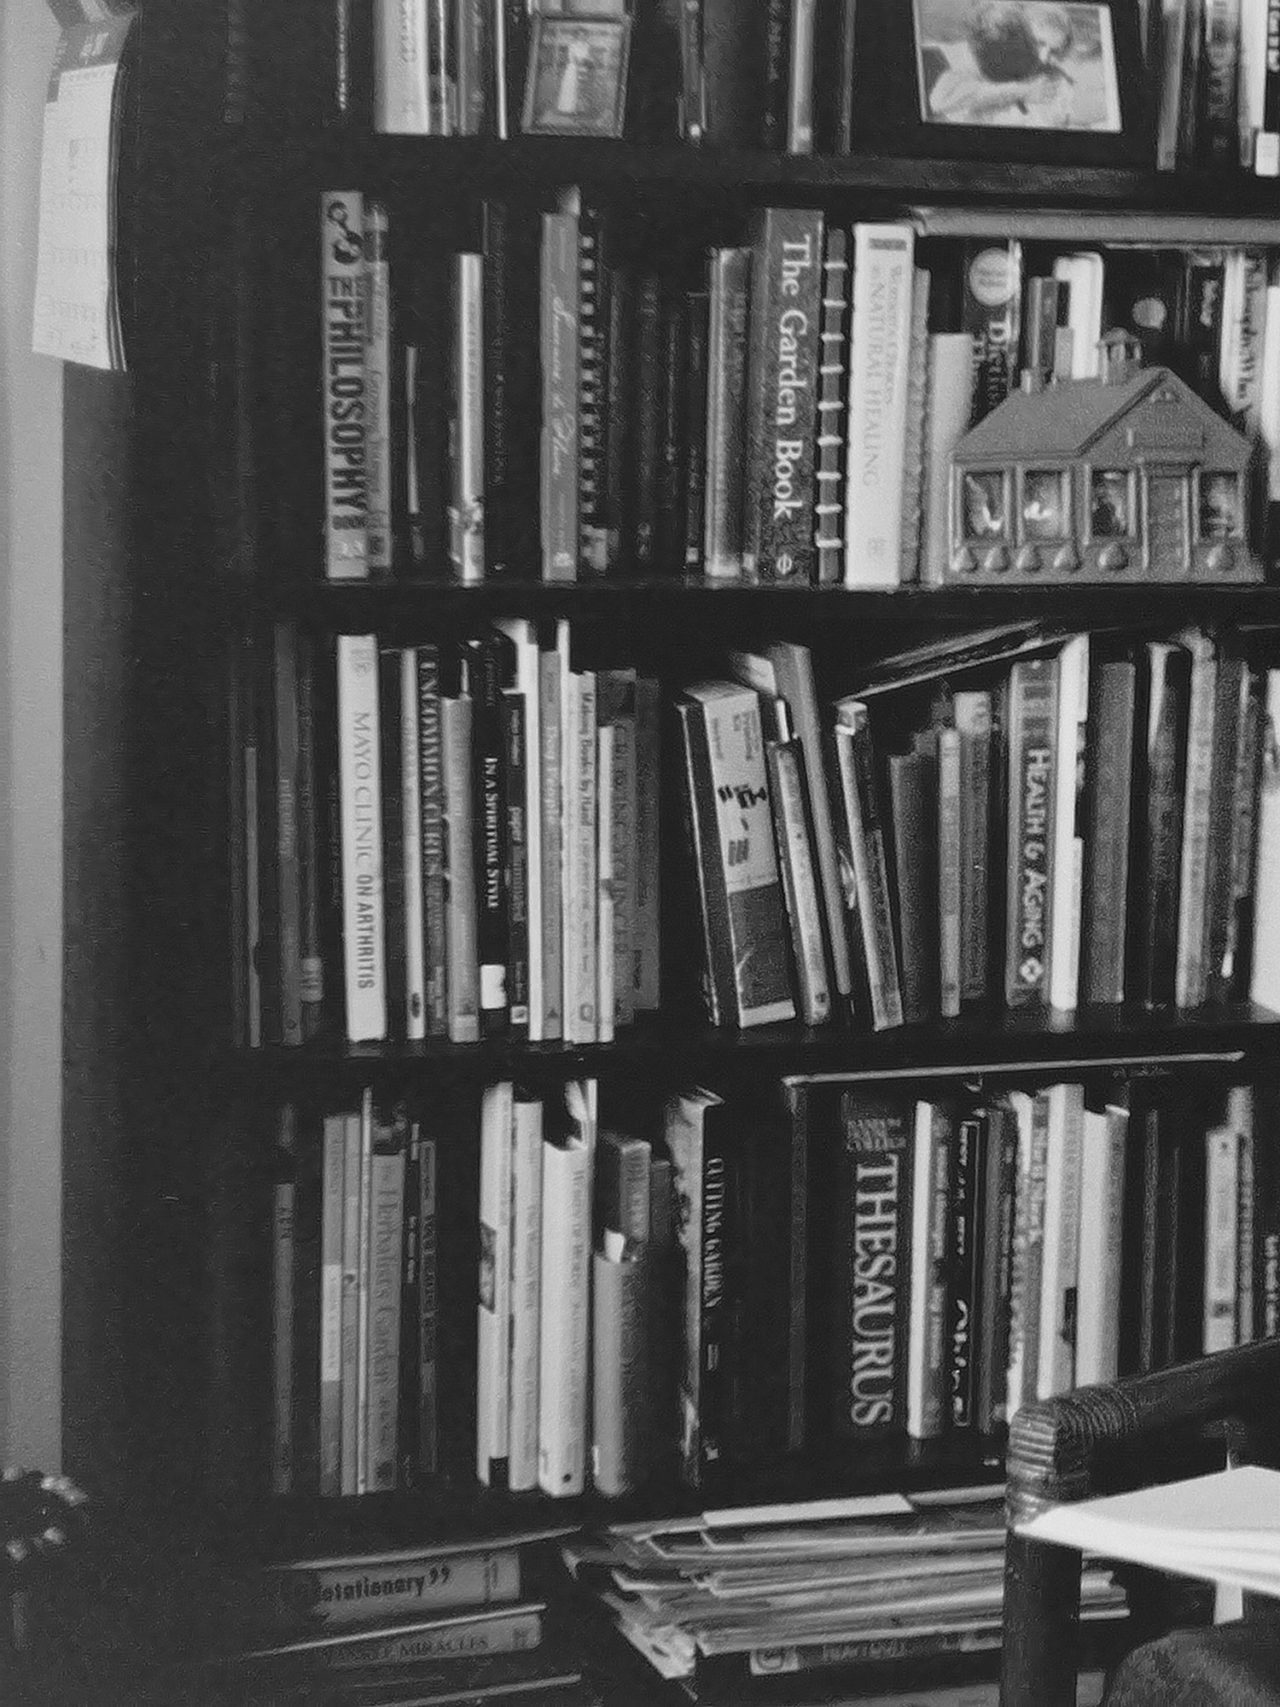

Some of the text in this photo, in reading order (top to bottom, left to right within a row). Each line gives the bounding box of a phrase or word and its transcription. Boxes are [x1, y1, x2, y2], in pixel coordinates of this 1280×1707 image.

[772, 233, 813, 521] The Garden Book
[867, 281, 885, 381] NATURAL
[328, 299, 367, 513] PHILOSOPHY
[862, 386, 884, 488] HEALING
[420, 661, 441, 797] UNCOMMON
[544, 726, 560, 761] Dog
[544, 766, 560, 825] People
[352, 711, 376, 990] MAYO CLINIC ON ARTHRITIS
[507, 806, 524, 843] paper
[1022, 748, 1051, 948] HEALTH & AGING
[703, 1158, 723, 1308] CUTTING GARDEN
[850, 1153, 899, 1425] THESAURUS
